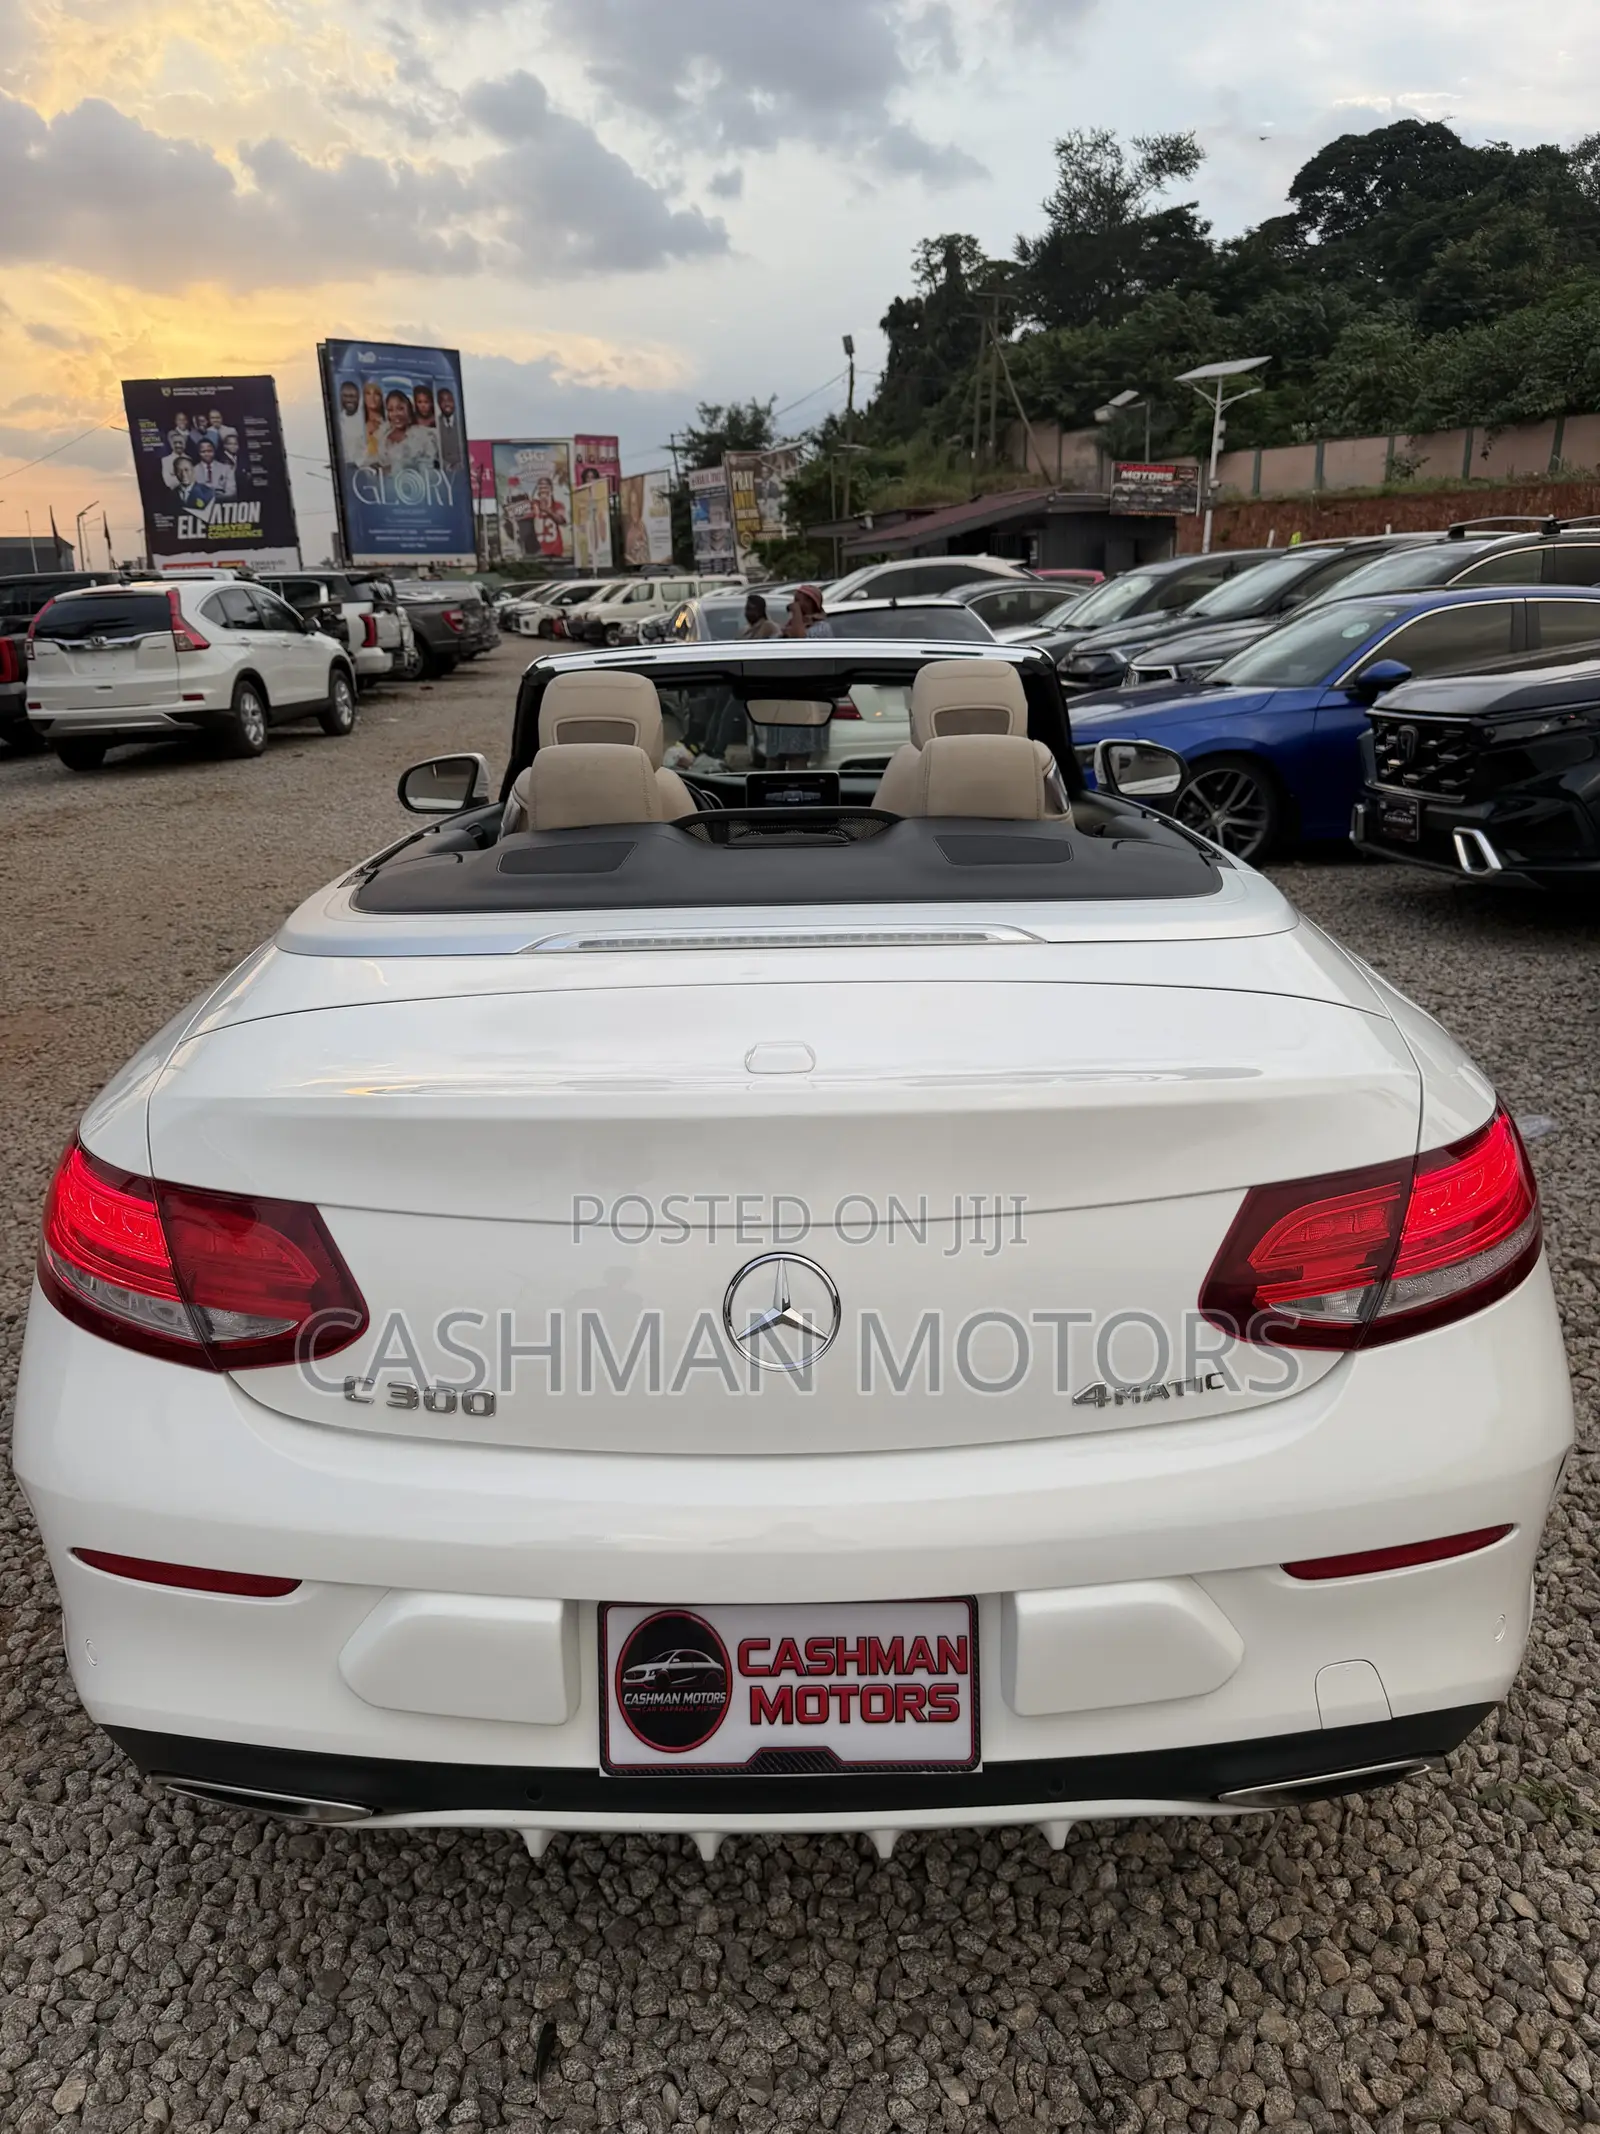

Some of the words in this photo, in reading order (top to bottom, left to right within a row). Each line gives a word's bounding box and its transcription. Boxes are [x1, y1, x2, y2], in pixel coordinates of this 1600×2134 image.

[352, 467, 457, 507] GLORY
[1120, 471, 1174, 481] MOTORS
[207, 529, 263, 540] CONFERENCE
[208, 522, 252, 533] PRAYER
[343, 1375, 376, 1404] C
[386, 1380, 498, 1417] 300
[1071, 1371, 1226, 1409] 4MATIC
[737, 1635, 969, 1677] CASHMAN
[623, 1692, 681, 1705] CASHMAN
[682, 1692, 727, 1704] MOTORS
[749, 1683, 961, 1725] MOTORS
